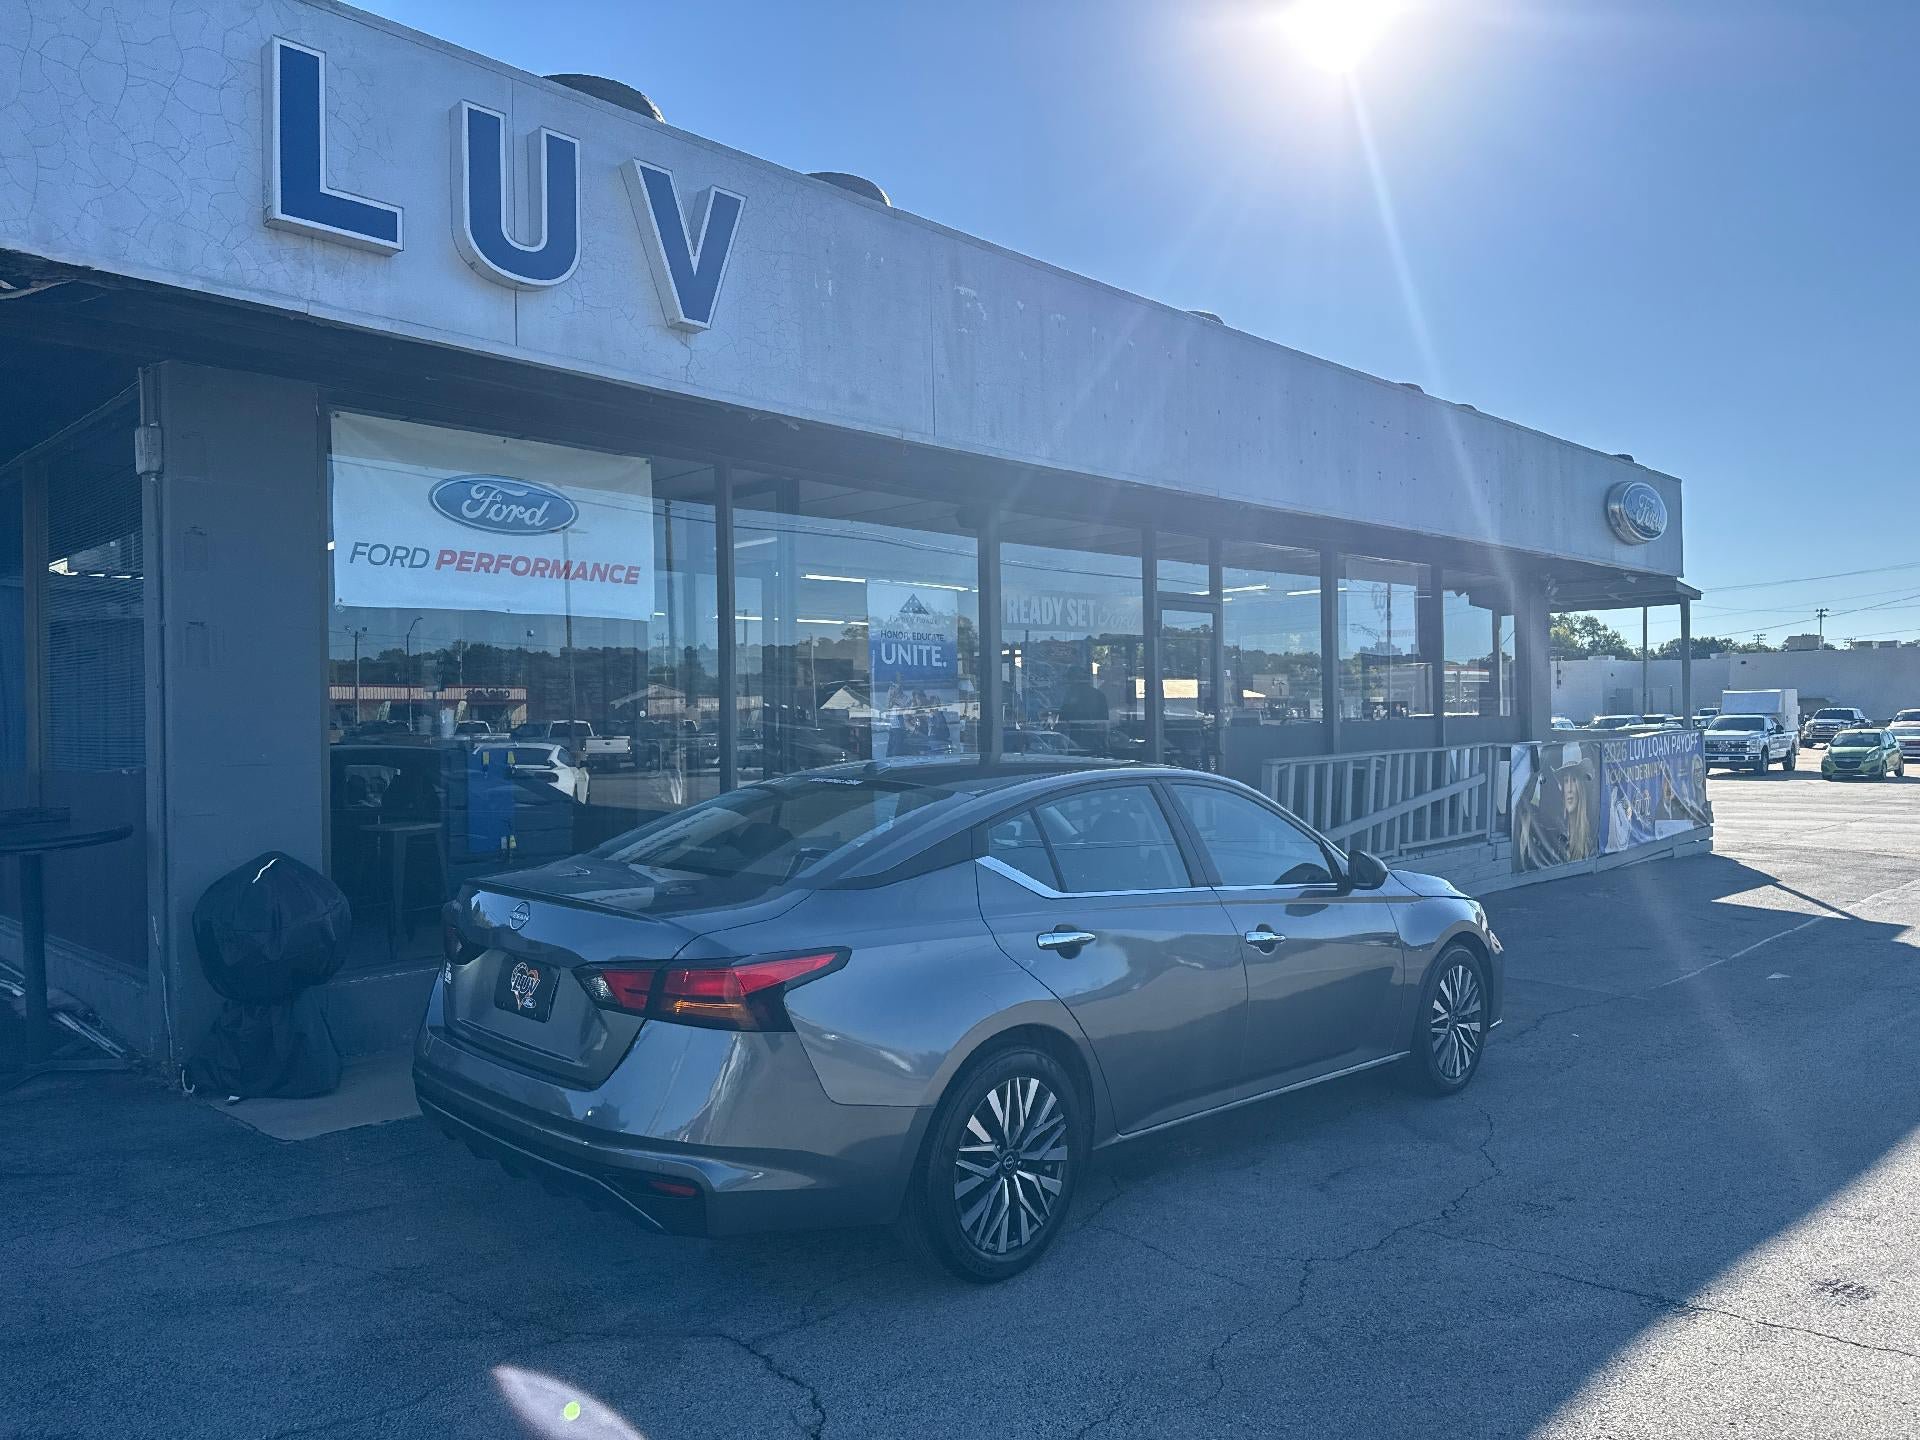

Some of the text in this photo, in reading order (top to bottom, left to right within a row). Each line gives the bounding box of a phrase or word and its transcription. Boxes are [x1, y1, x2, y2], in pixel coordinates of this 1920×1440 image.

[263, 35, 748, 333] LUV
[461, 483, 549, 527] Ford
[350, 541, 641, 585] FORD PERFORMANCE
[1006, 596, 1064, 625] READY
[1067, 599, 1096, 627] SET
[881, 642, 947, 667] UNITE.
[1629, 740, 1646, 761] LUV
[1648, 736, 1669, 757] LOAN
[1671, 732, 1699, 754] PAYOFF
[511, 973, 540, 995] LUV
